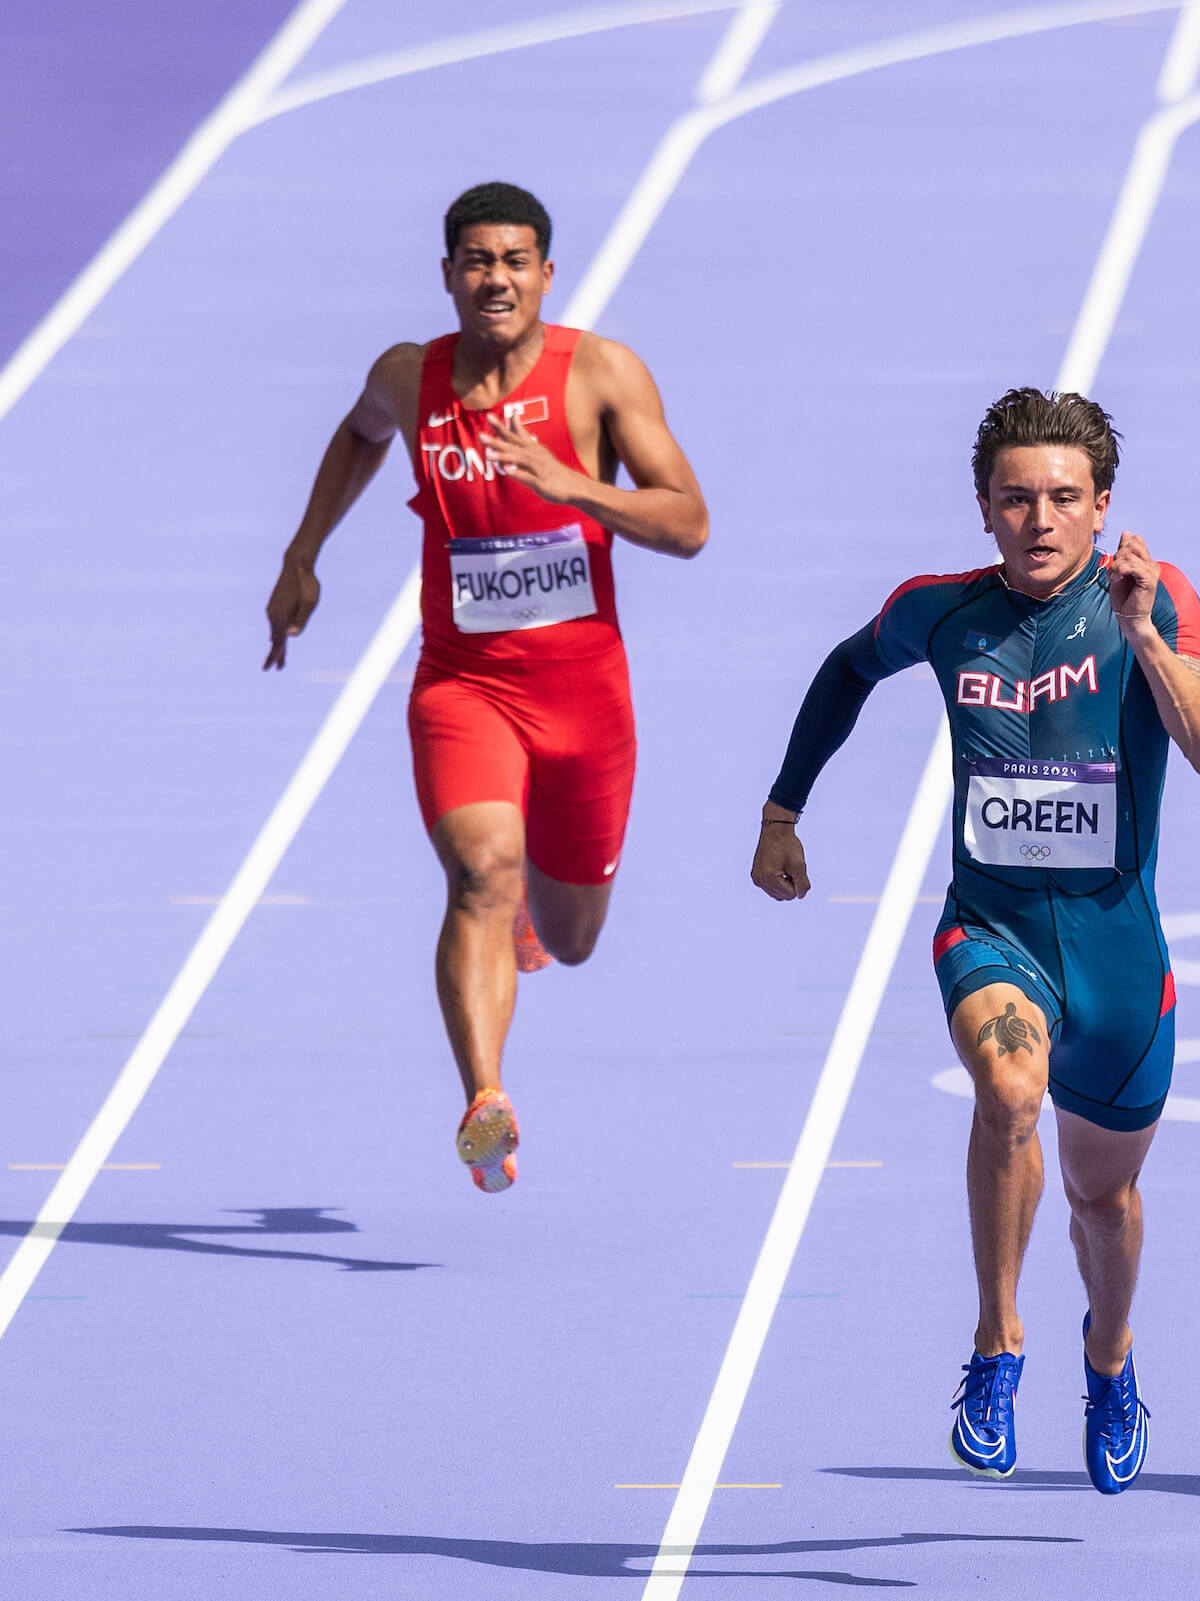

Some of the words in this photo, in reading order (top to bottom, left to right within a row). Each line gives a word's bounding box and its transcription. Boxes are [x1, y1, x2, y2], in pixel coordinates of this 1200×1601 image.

[456, 557, 587, 601] FUKOFUKA
[957, 655, 1099, 713] GUAM
[1003, 763, 1039, 775] PARIS
[1043, 766, 1077, 777] 2024
[982, 797, 1098, 834] GREEN
